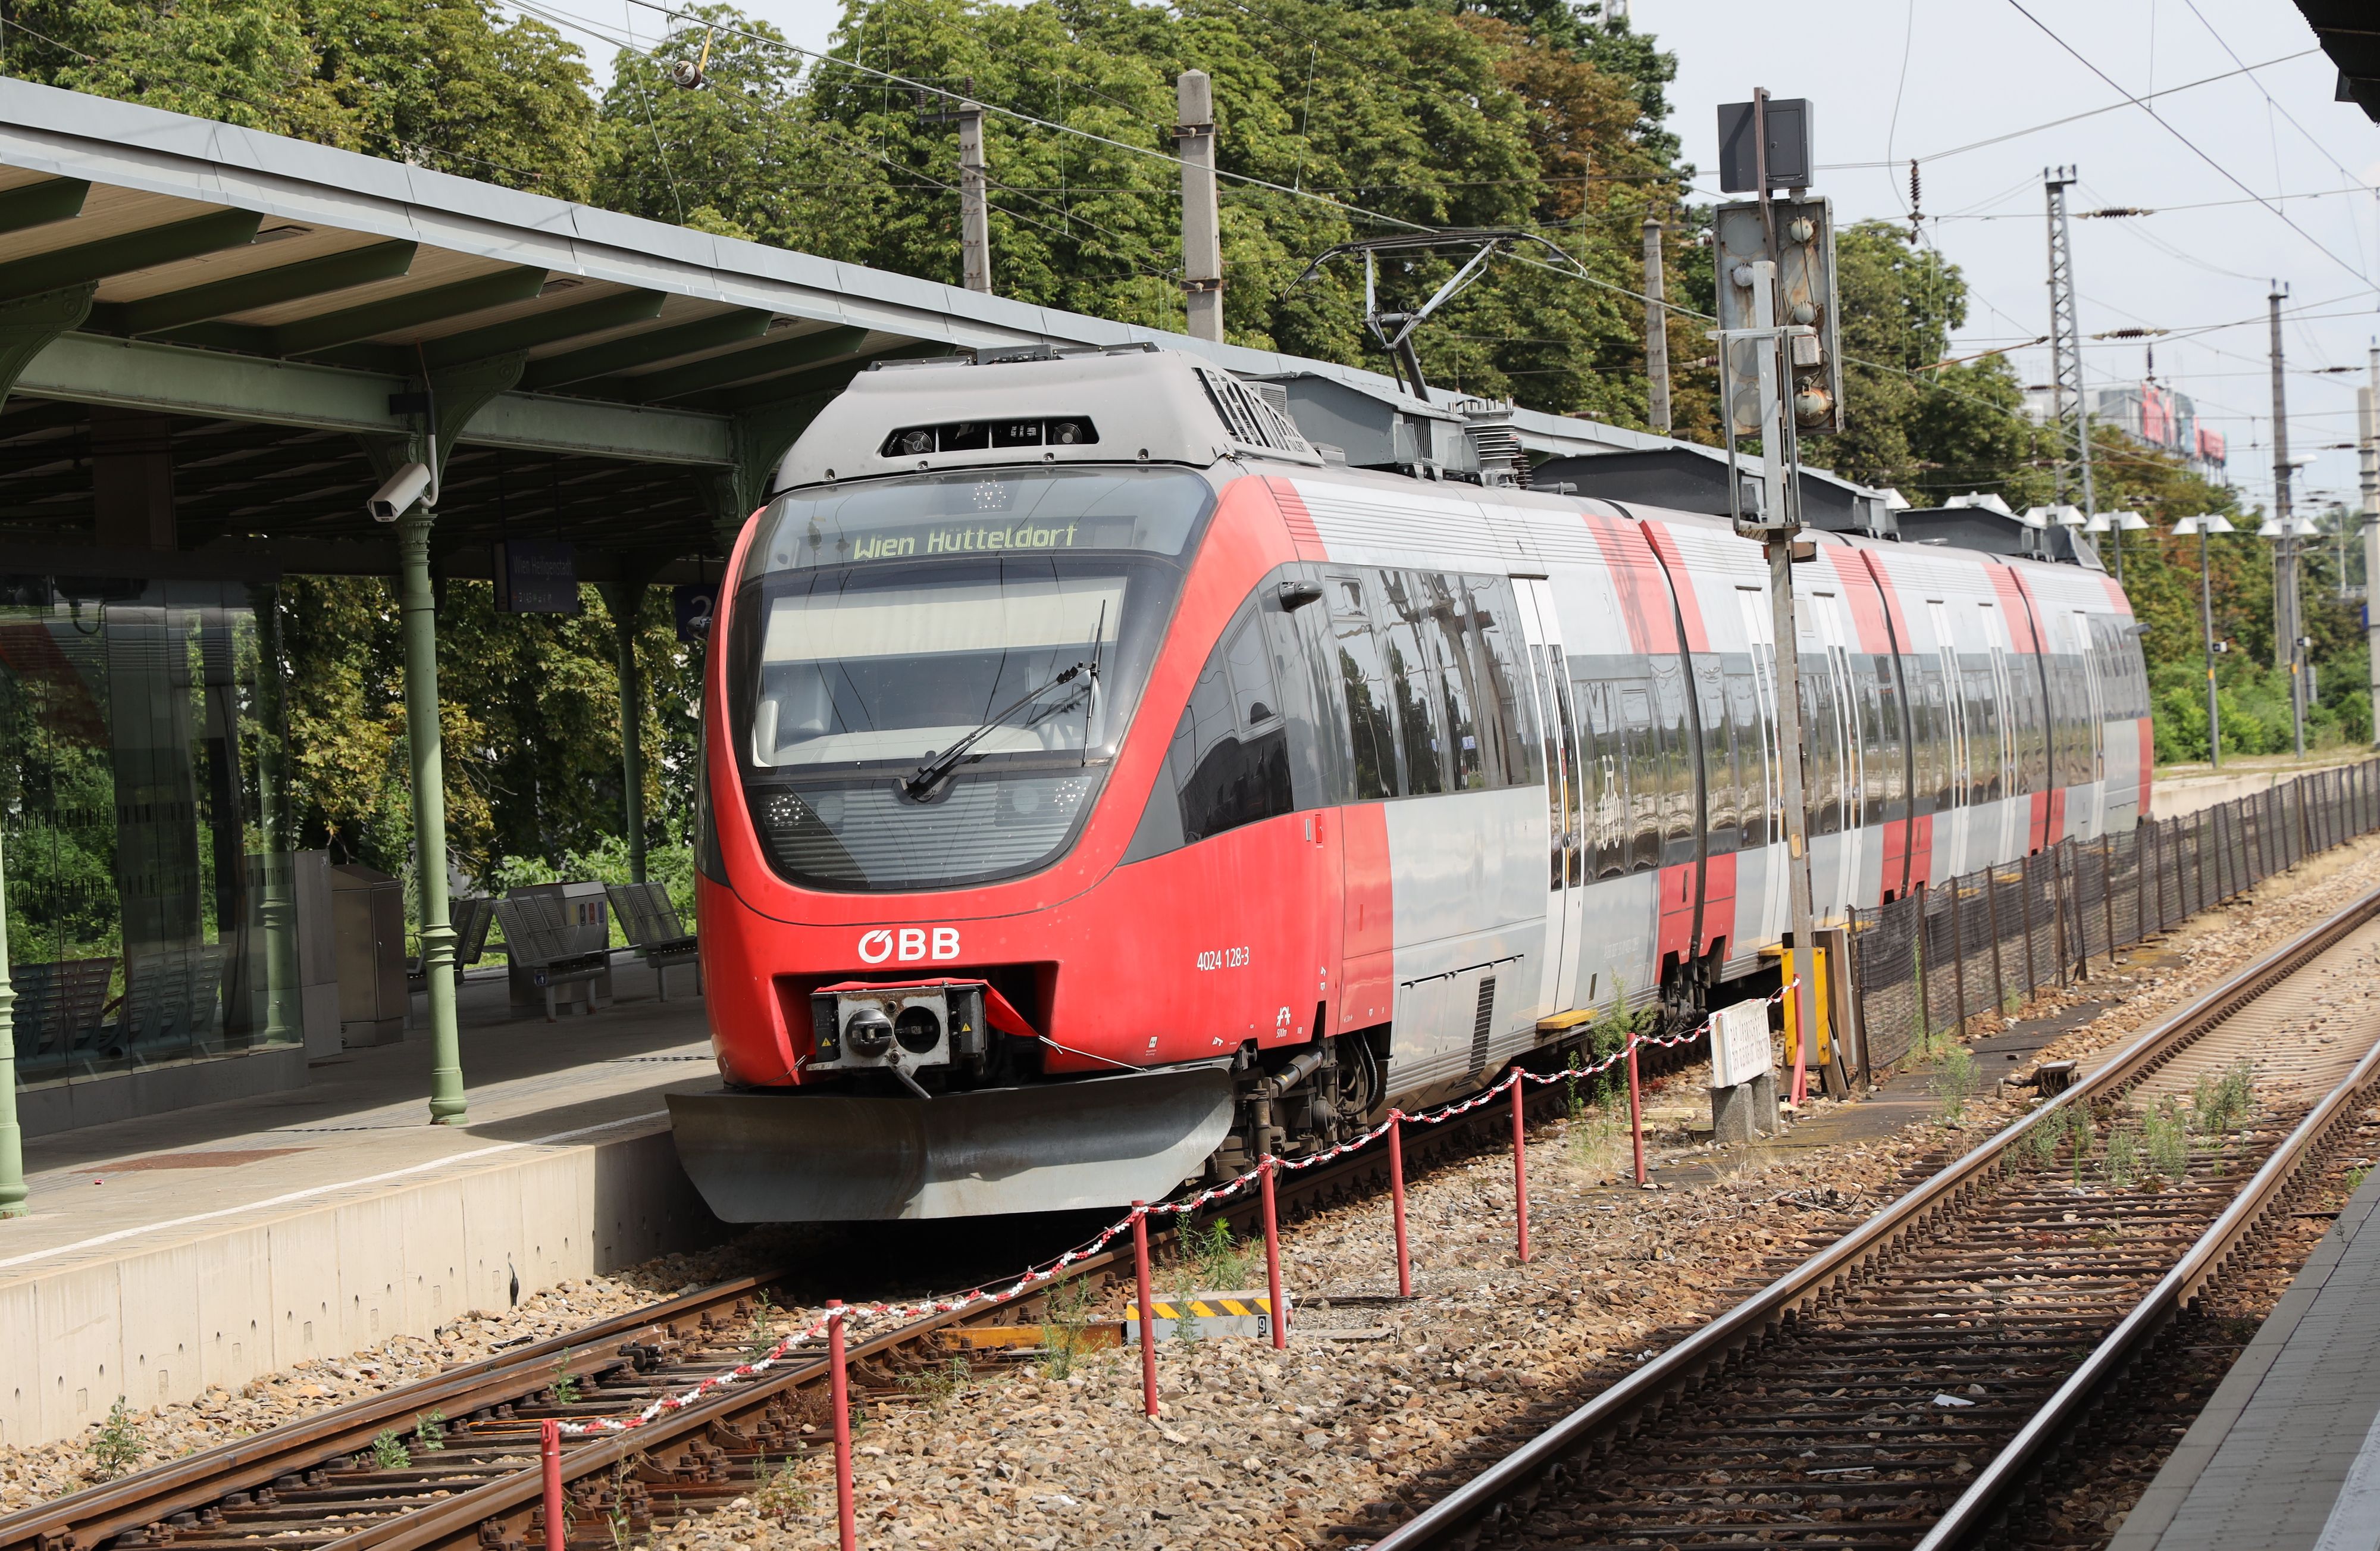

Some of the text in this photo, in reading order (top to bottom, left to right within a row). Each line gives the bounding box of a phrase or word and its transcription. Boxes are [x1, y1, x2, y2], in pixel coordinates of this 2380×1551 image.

[853, 522, 1079, 561] Wien Hütteldorf
[513, 554, 573, 581] Wien Heiligenstadt
[858, 927, 960, 964] ÖBB
[1197, 946, 1250, 971] 4024 128-3
[1259, 1318, 1266, 1332] 9
